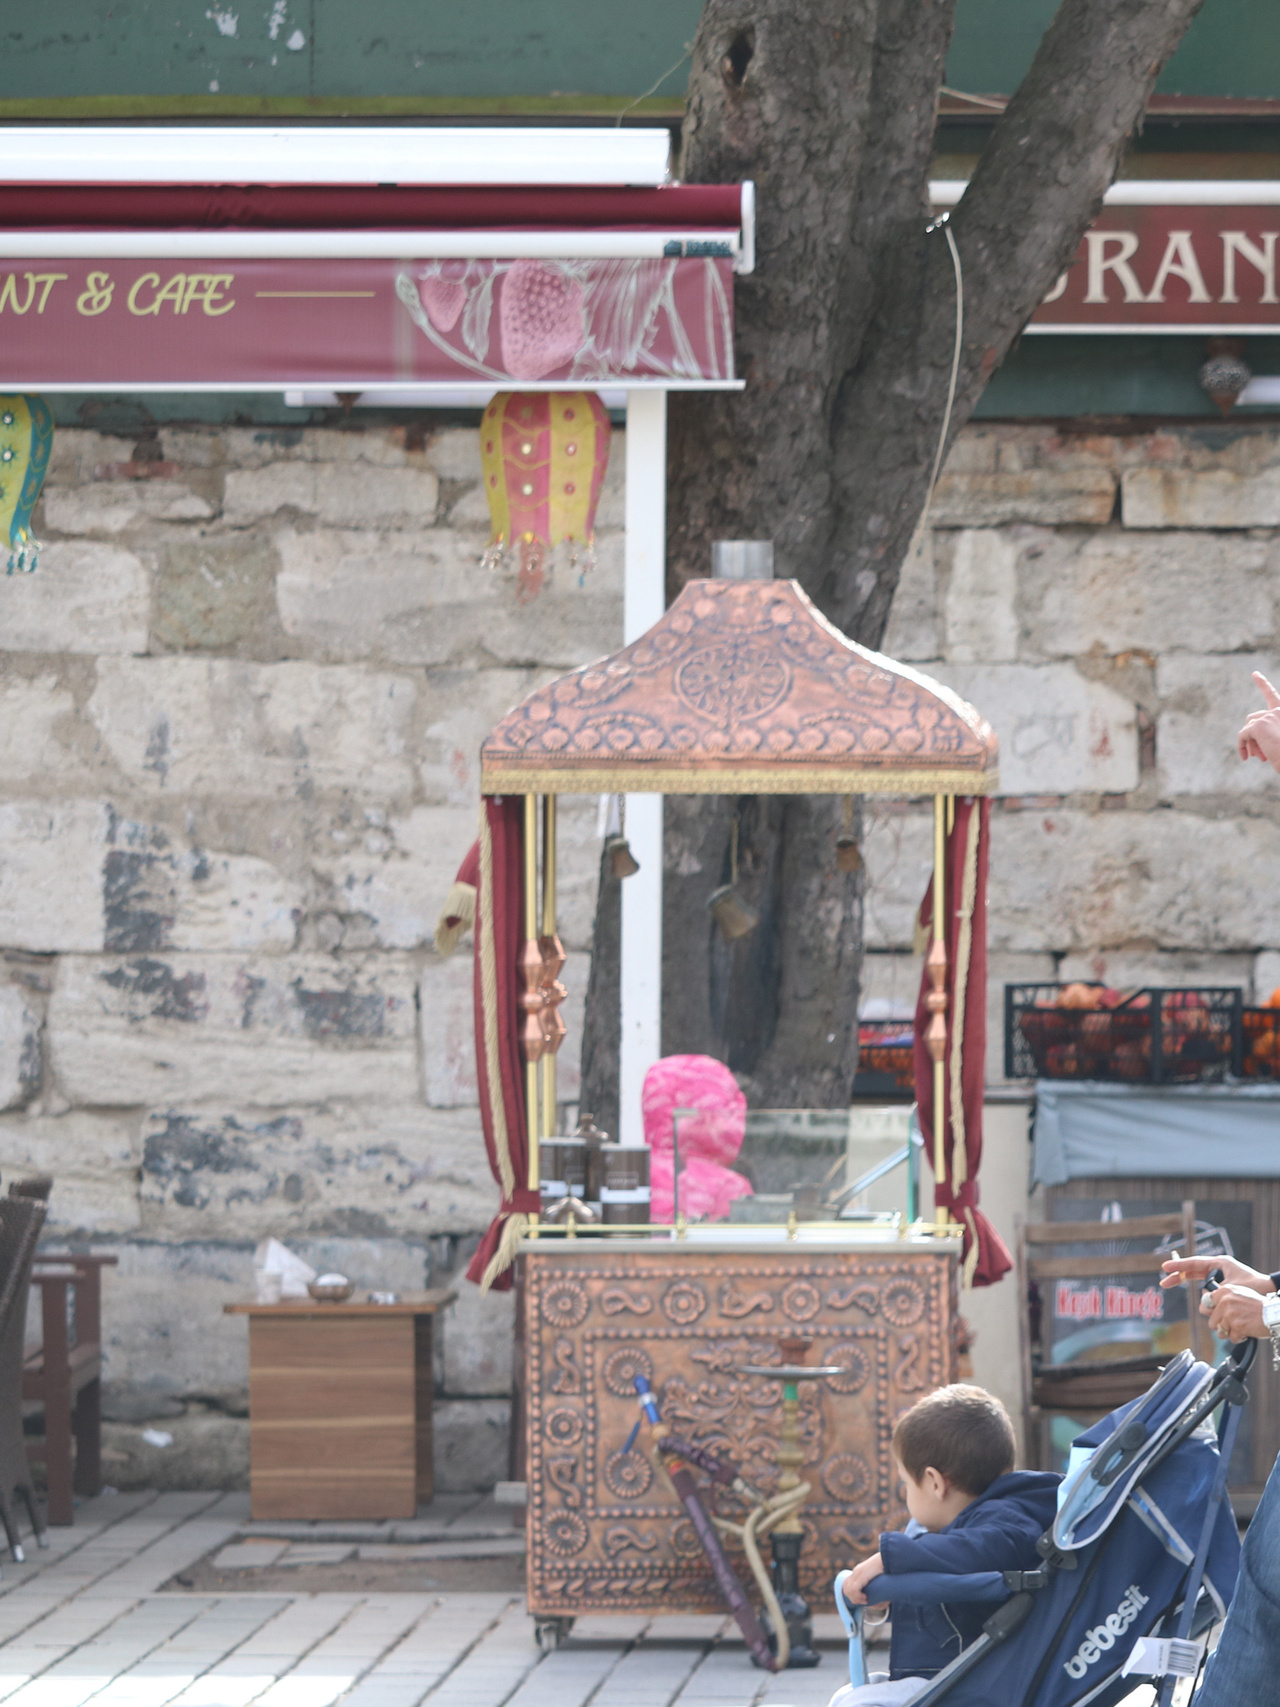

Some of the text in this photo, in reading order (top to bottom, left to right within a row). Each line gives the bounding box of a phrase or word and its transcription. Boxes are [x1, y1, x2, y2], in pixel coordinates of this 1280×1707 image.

[76, 271, 116, 317] &
[127, 271, 236, 317] CAFE
[1063, 1584, 1150, 1679] bebesit
